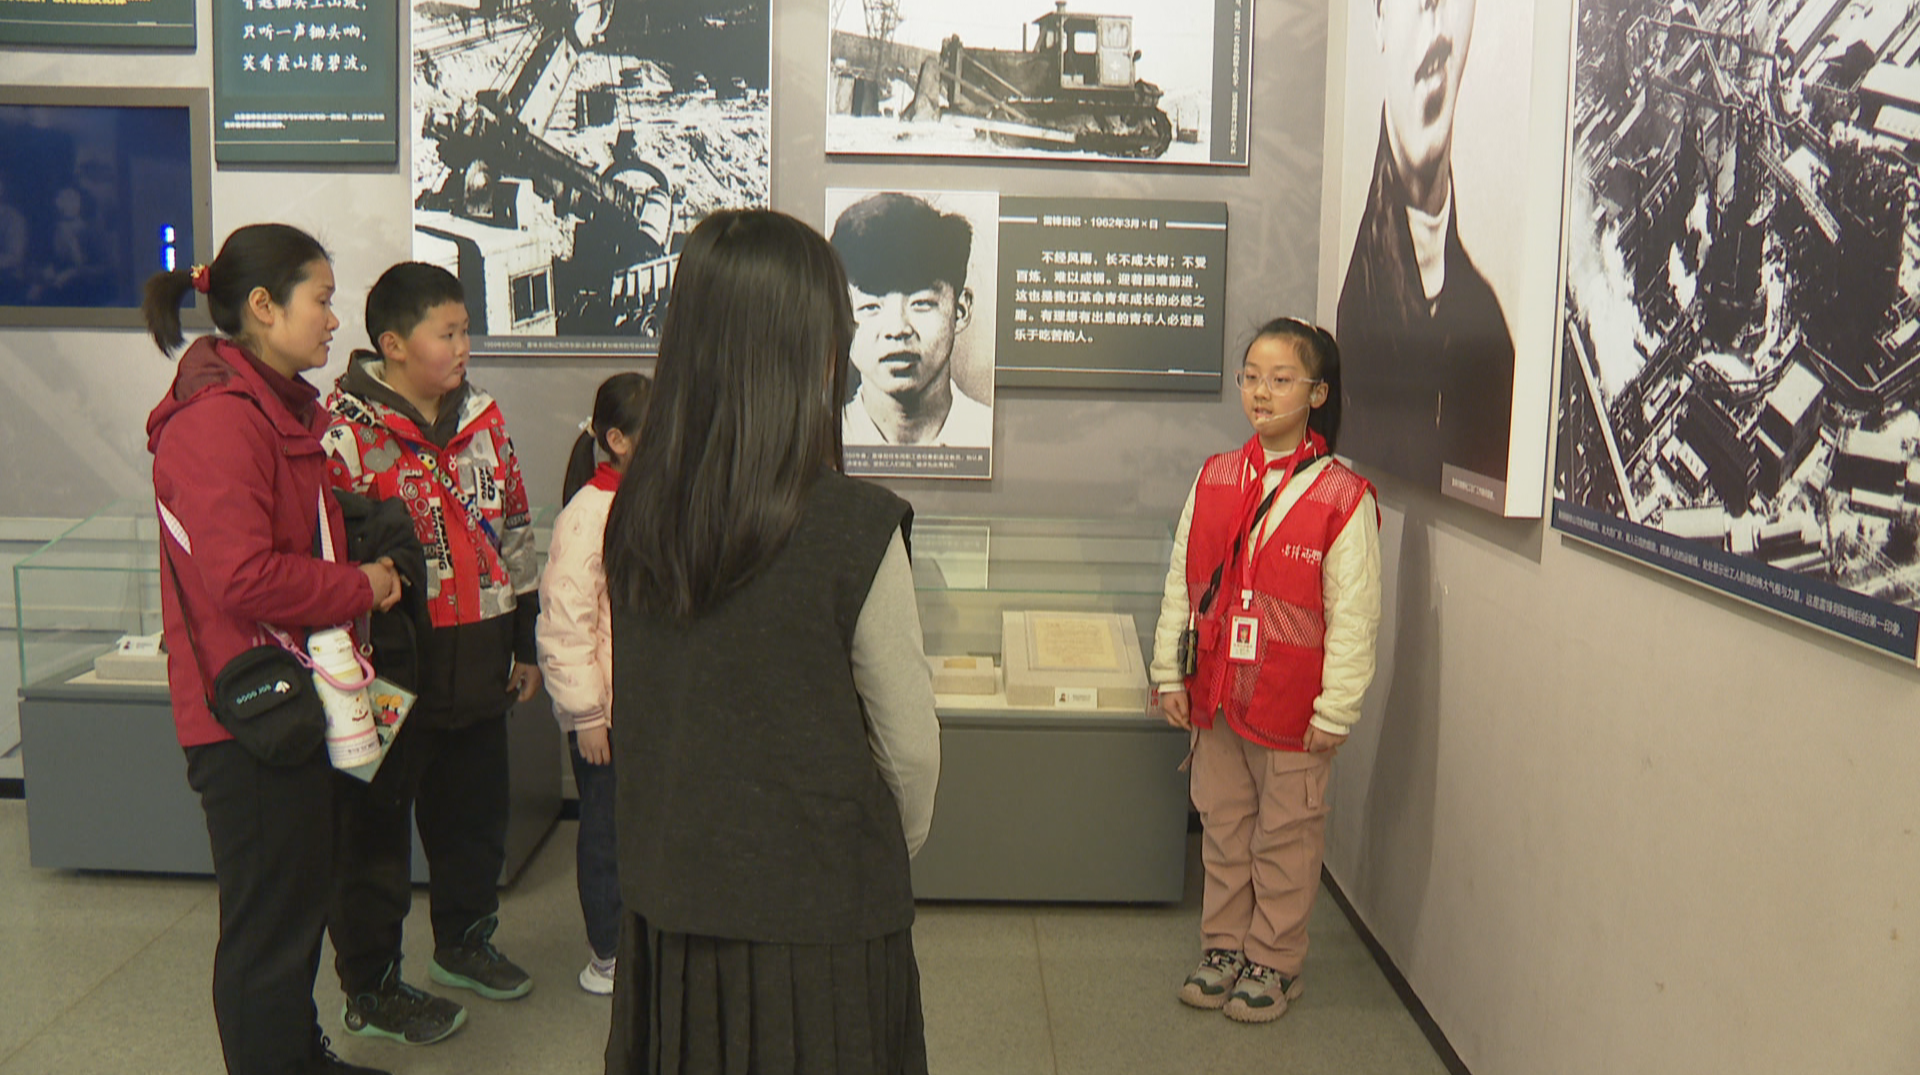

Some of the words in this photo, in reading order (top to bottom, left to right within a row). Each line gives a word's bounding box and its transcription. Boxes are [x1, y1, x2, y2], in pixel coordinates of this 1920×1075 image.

[242, 22, 368, 41] 只听一声锄头响，
[242, 53, 368, 72] 笑看荒山荡碧波。
[1015, 288, 1205, 308] 这也是我们革命青年成长的必经之
[1014, 308, 1205, 328] 路。有理想有出息的青年人必定是
[1014, 328, 1094, 344] 乐于吃苦的人。
